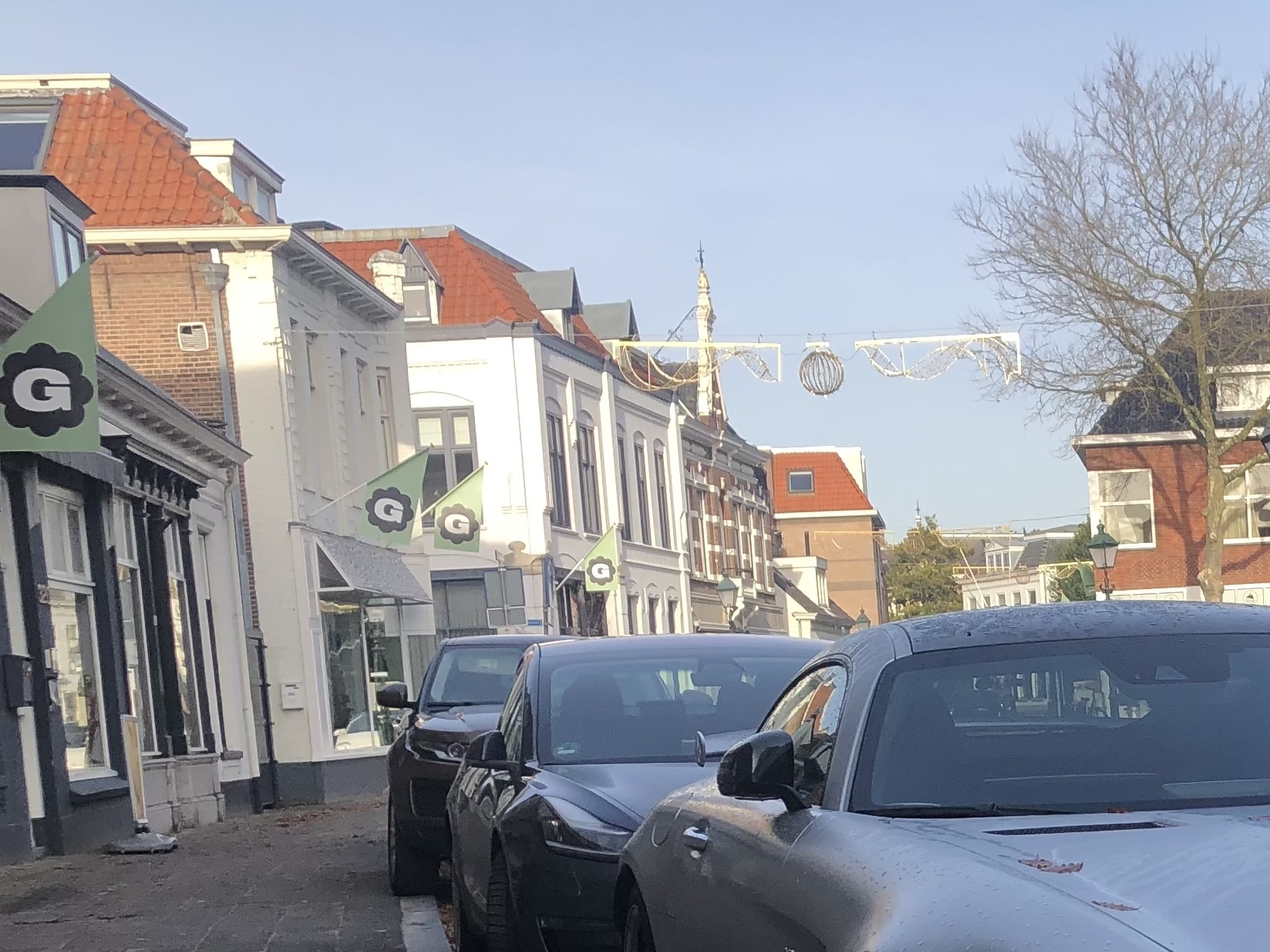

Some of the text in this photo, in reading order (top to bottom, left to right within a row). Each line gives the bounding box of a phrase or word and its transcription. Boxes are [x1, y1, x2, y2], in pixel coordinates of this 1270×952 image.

[13, 367, 71, 412] G
[374, 498, 404, 524] G
[444, 513, 470, 535] G
[591, 563, 610, 579] G
